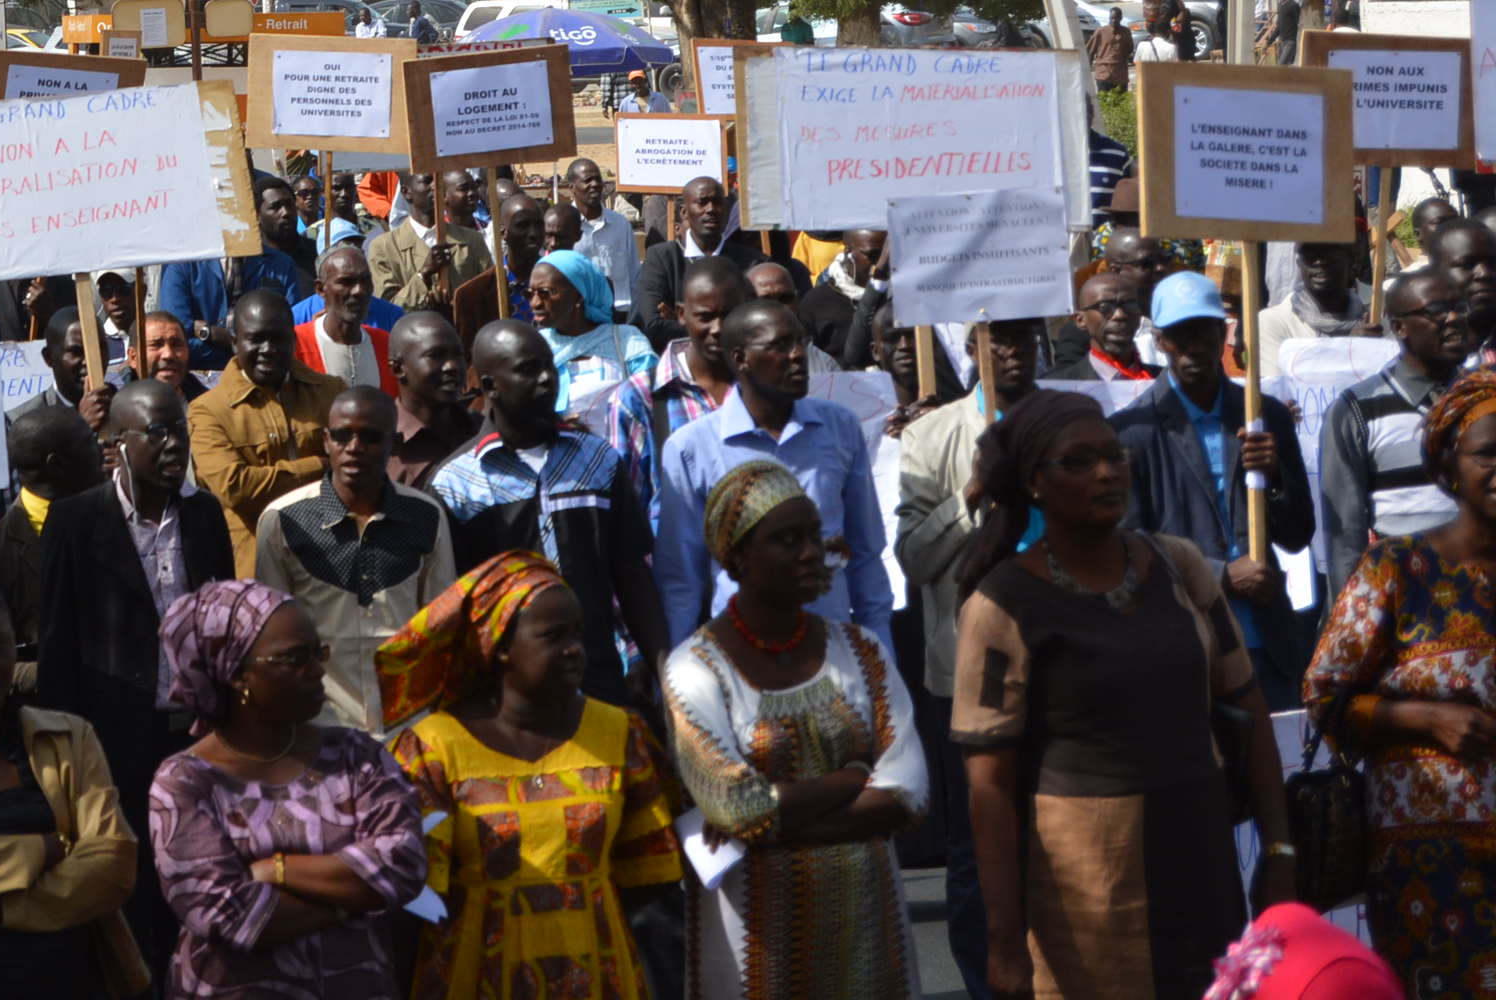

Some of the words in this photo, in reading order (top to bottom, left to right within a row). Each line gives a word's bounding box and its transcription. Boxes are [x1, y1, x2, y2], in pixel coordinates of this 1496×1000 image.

[266, 19, 308, 31] Retrait
[549, 27, 597, 46] tigo
[324, 63, 341, 71] OUI
[843, 53, 917, 75] GRAND
[933, 55, 1001, 75] CADRE
[1366, 65, 1394, 76] NON
[1398, 66, 1425, 76] AUX
[37, 77, 61, 88] NON
[63, 80, 71, 89] A
[74, 81, 88, 91] LA
[284, 73, 310, 81] POUR
[312, 74, 332, 82] UNE
[334, 75, 379, 84] RETRAITE
[307, 86, 336, 94] DIGNE
[464, 89, 499, 101] DROIT
[502, 87, 518, 96] AU
[801, 85, 856, 103] EXIGE
[871, 85, 895, 102] LA
[900, 83, 1046, 103] MATERIALISATION
[1394, 83, 1448, 94] IMPUNIS
[290, 97, 352, 106] PERSONNELS
[354, 98, 373, 106] DES
[457, 101, 519, 116] LOGEMENT
[1356, 99, 1444, 111] L'UNIVERSITE
[300, 108, 362, 117] UNIVERSITES
[446, 117, 480, 127] RESPECT
[477, 125, 506, 134] DECRET
[800, 124, 841, 143] DES
[1191, 123, 1274, 138] L'ENSEIGNANT
[1277, 128, 1308, 140] DANS
[54, 136, 70, 156] A
[83, 130, 116, 151] LA
[1190, 140, 1205, 151] LA
[1208, 141, 1255, 154] GALERE,
[1258, 144, 1290, 156] C'EST
[1293, 146, 1307, 157] LA
[634, 148, 693, 156] ABROGATION
[155, 153, 178, 172] DU
[826, 151, 1033, 186] PRESIDENTIELLES
[1200, 158, 1247, 170] SOCIETE
[1250, 160, 1281, 173] DANS
[1284, 162, 1299, 174] LA
[1225, 176, 1265, 189] MISERE
[31, 187, 176, 234] ENSEIGNANT
